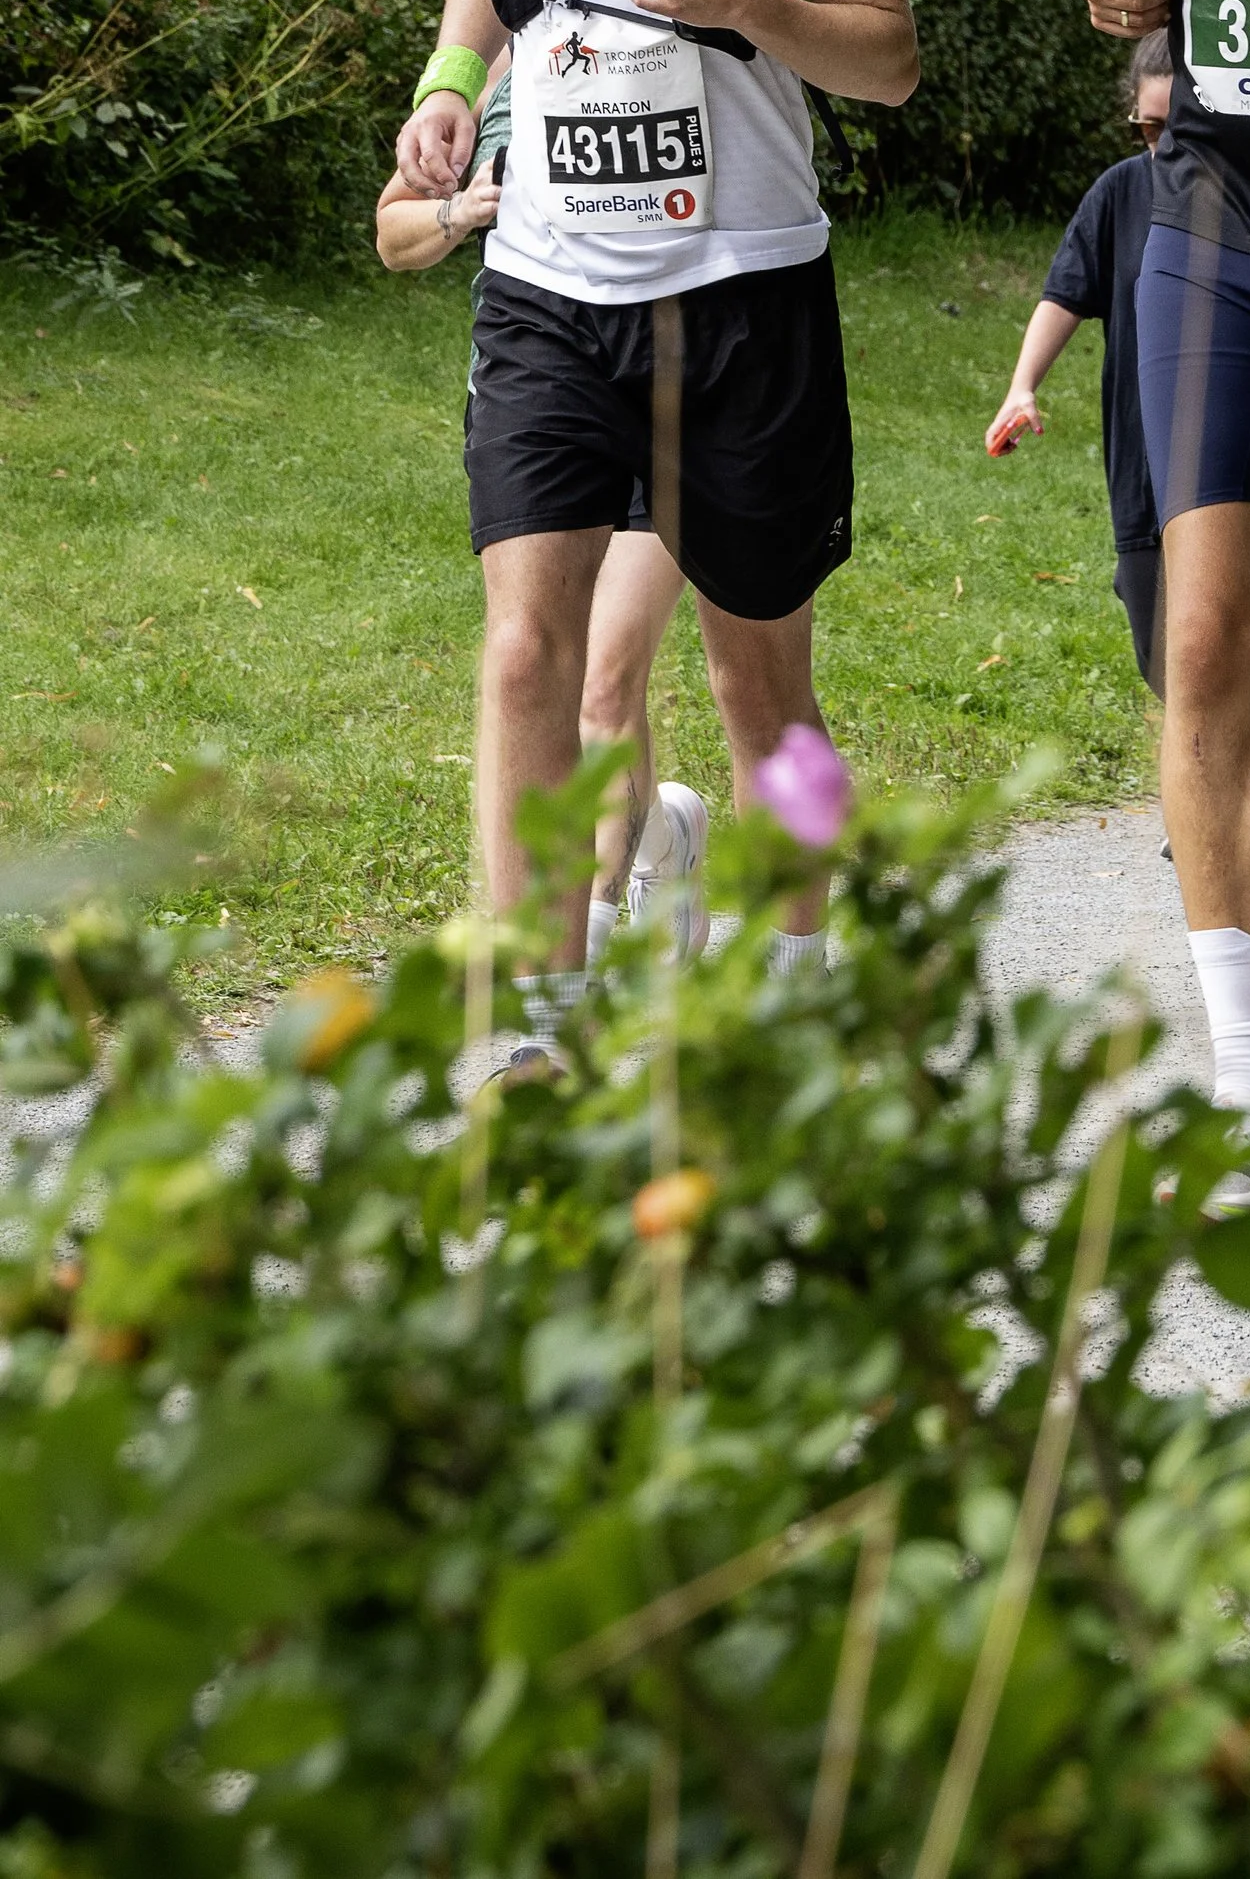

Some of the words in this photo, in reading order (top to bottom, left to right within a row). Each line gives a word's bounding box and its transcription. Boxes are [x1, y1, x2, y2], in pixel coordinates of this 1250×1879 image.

[604, 44, 679, 63] TRONDHEIM
[607, 60, 668, 75] MARATON
[581, 100, 651, 115] MARATON
[685, 115, 702, 157] PULJE
[551, 119, 686, 176] 43115
[692, 158, 703, 167] 3
[564, 194, 660, 215] SpareBank
[637, 213, 663, 223] SMN
